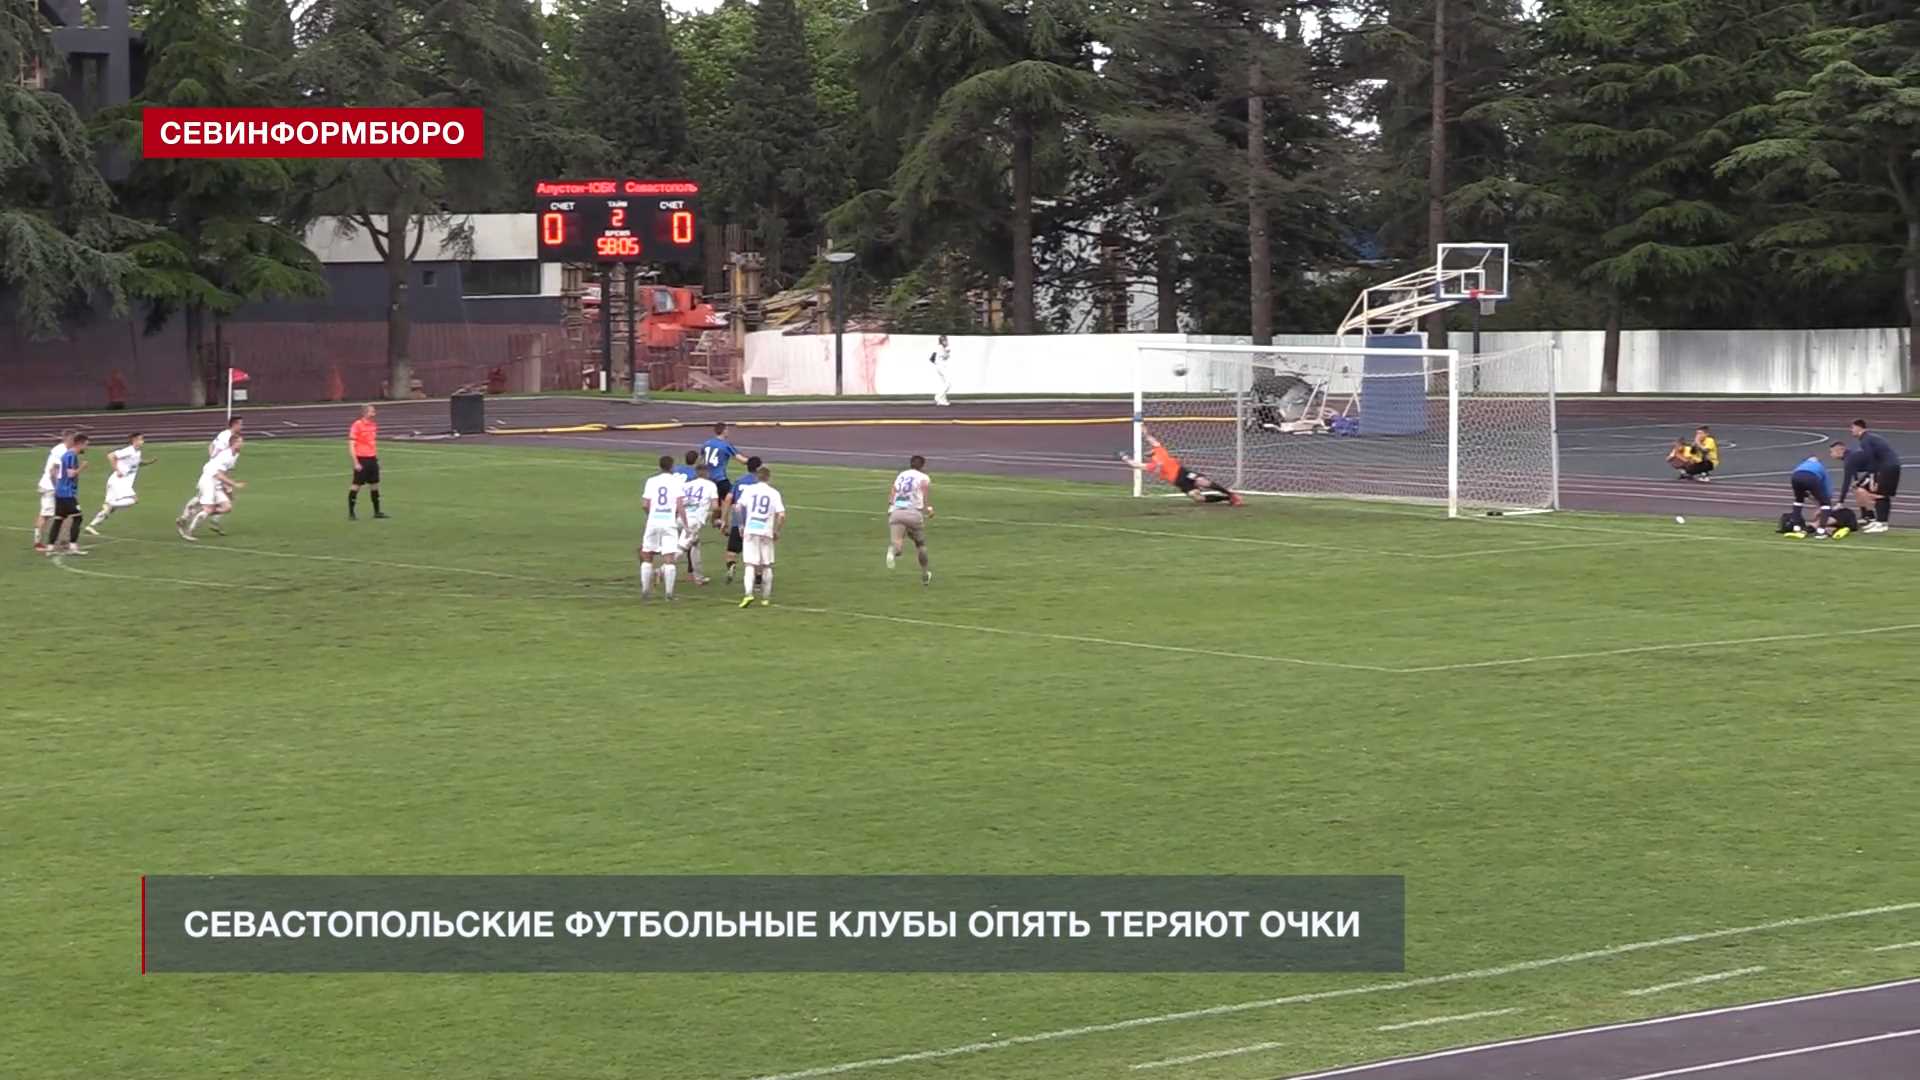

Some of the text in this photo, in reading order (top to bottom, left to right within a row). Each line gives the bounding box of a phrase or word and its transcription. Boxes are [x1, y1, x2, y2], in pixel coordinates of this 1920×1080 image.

[550, 202, 575, 210] СЧЕТ
[660, 201, 684, 209] СЧЕТ
[612, 209, 624, 226] 2
[673, 212, 691, 243] 0
[544, 213, 562, 244] 0
[704, 446, 719, 467] 14
[657, 486, 668, 506] 8
[751, 494, 770, 515] 19
